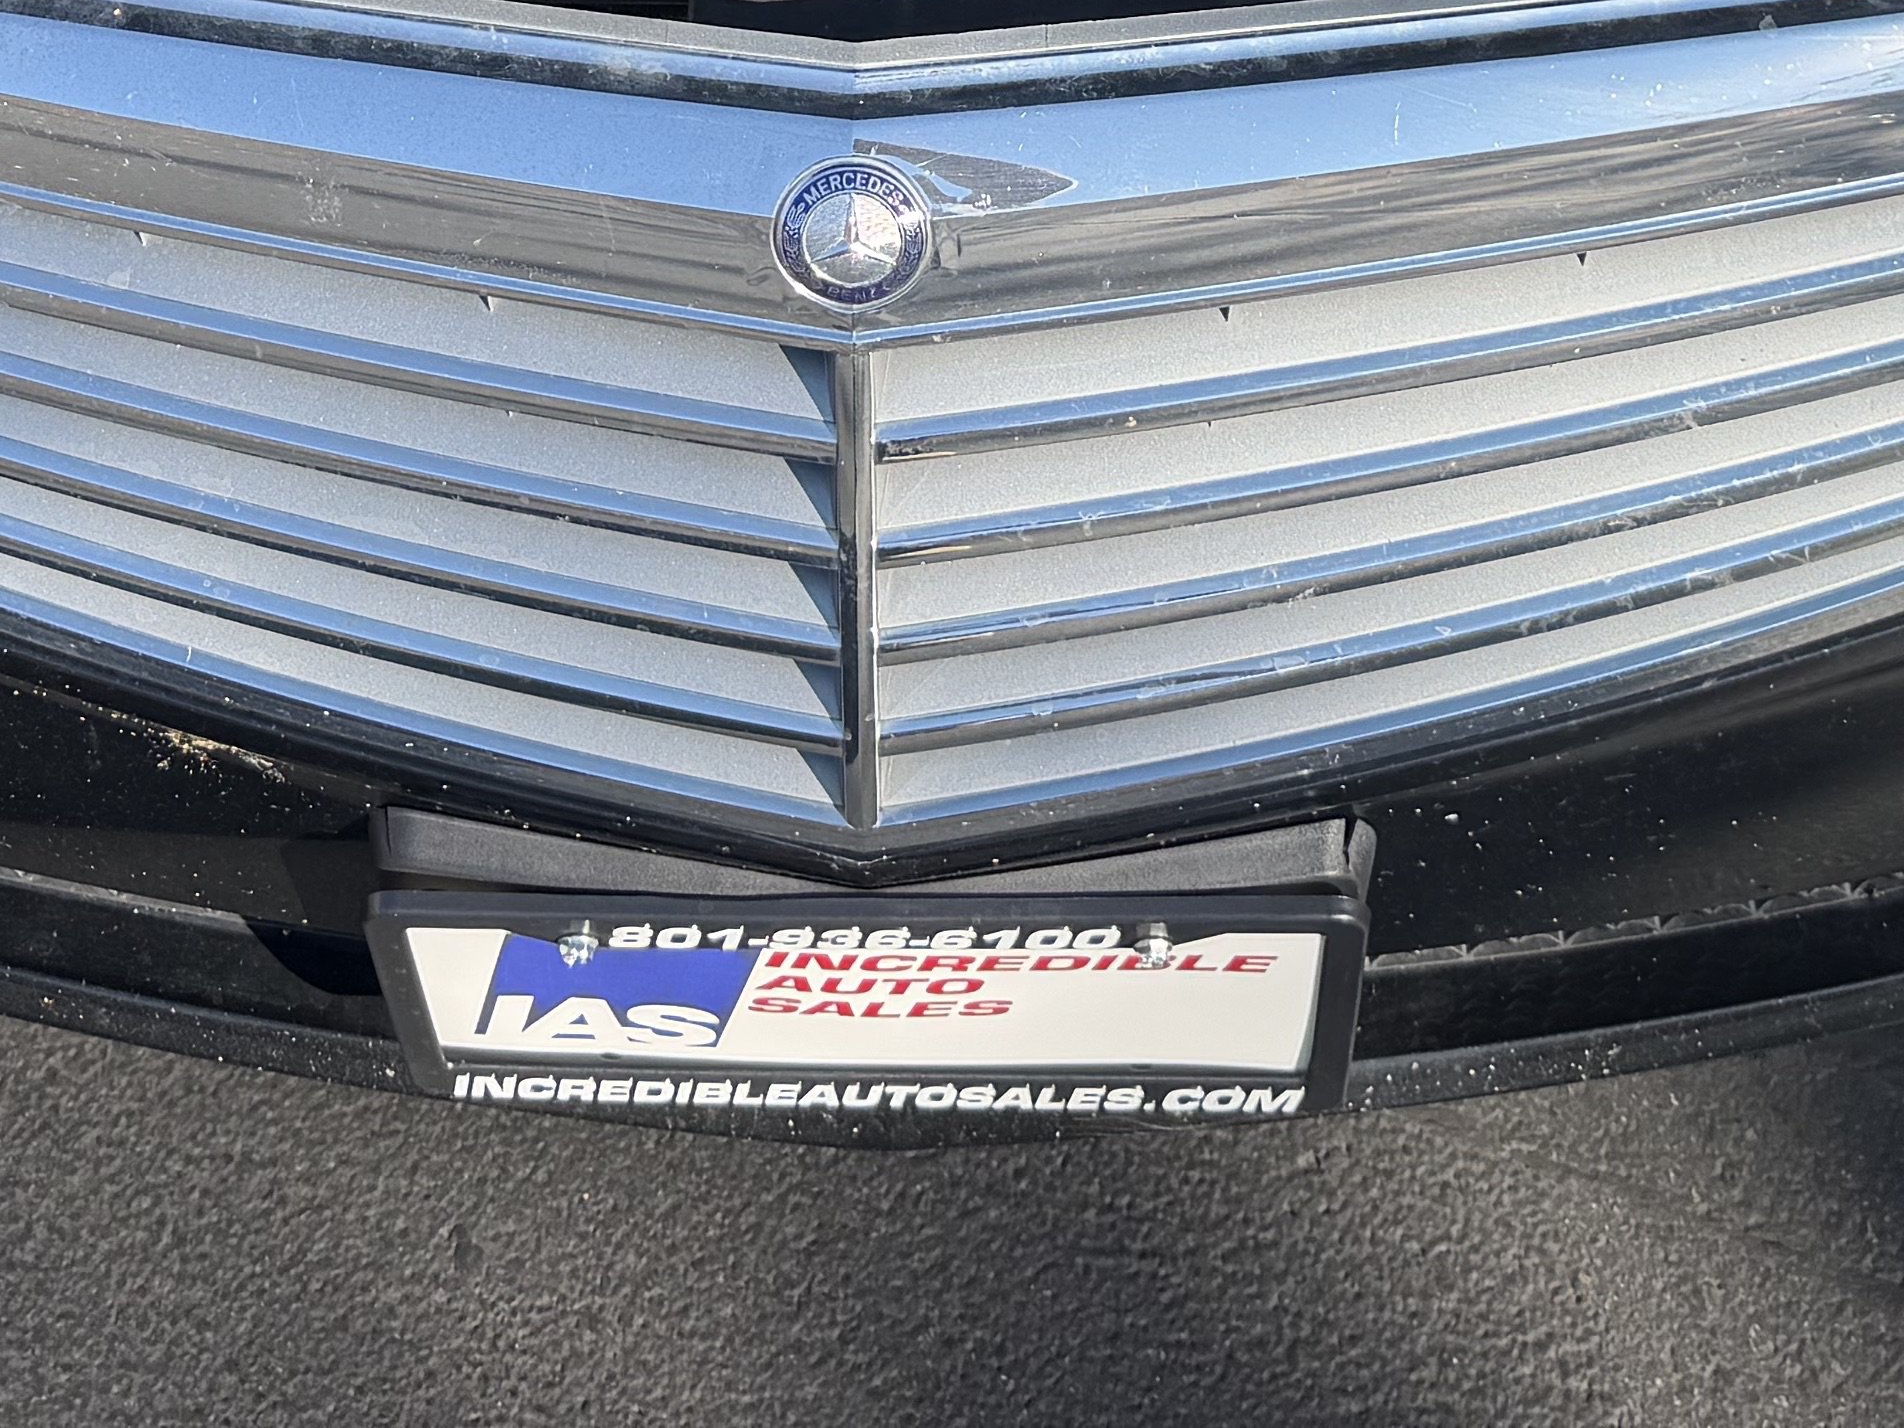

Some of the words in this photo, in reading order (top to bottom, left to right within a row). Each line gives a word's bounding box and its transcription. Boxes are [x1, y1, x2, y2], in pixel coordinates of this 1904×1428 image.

[802, 172, 905, 206] MERCEDES
[826, 285, 878, 303] BENZ
[608, 922, 1122, 952] 801-936-6100
[764, 951, 1279, 974] INCREDIBLE
[754, 975, 986, 995] AUTO
[484, 994, 722, 1046] IAS
[748, 997, 1014, 1018] SALES
[452, 1071, 1306, 1114] INCREDIBLEAUTOSALES.COM
